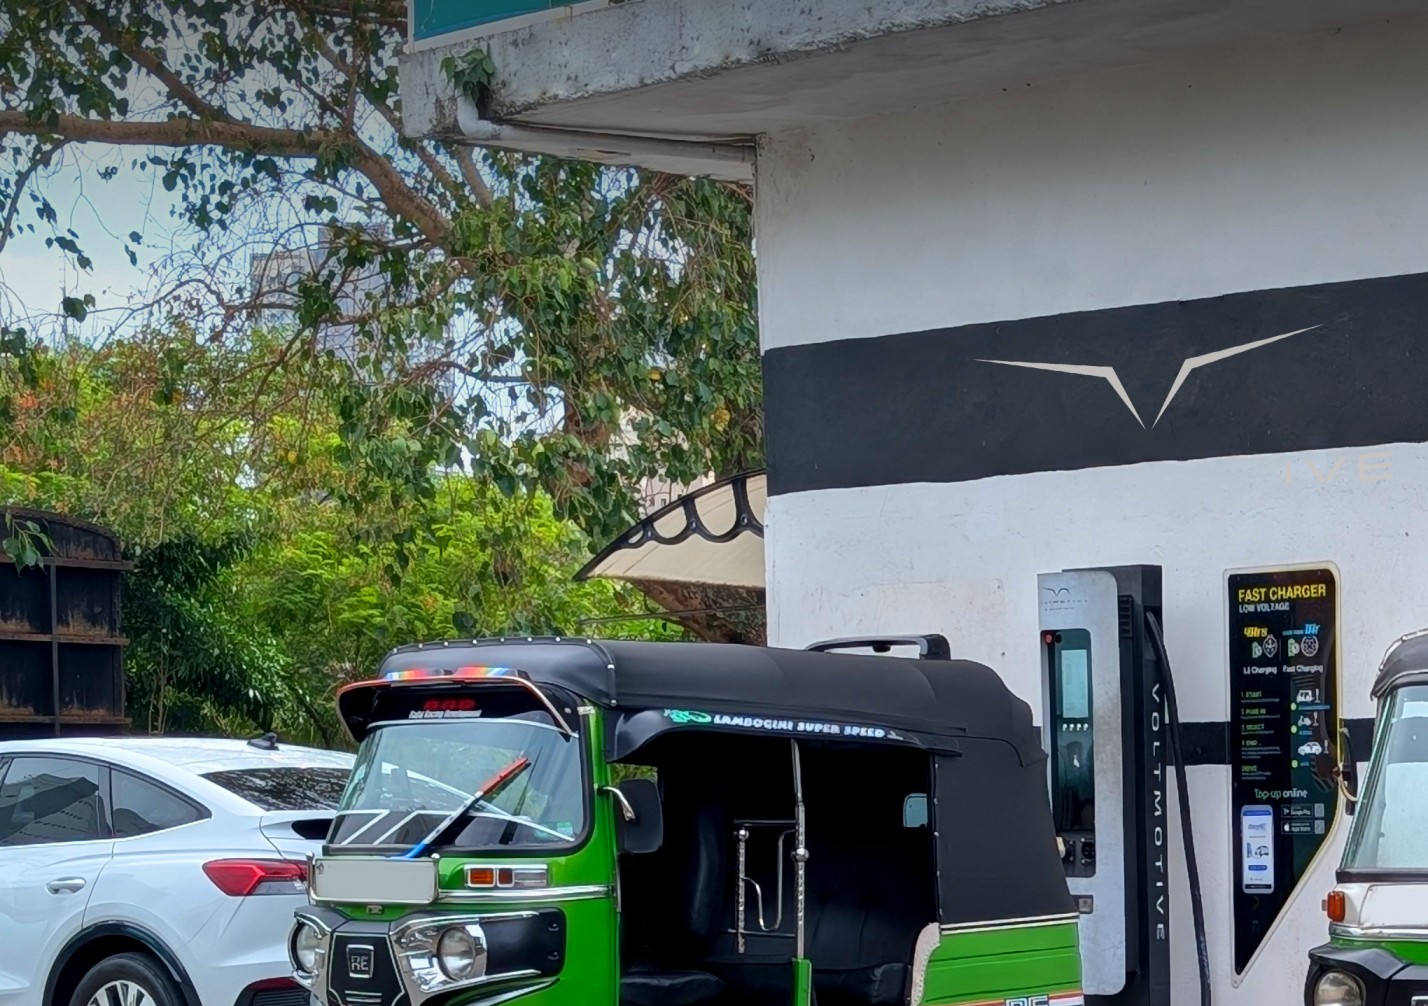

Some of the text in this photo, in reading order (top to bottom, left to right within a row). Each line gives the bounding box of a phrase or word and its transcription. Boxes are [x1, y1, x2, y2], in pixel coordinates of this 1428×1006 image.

[1238, 583, 1327, 602] FAST CHARGER
[797, 722, 840, 735] SUPER
[843, 726, 886, 738] SPEED
[1282, 787, 1309, 799] online
[1151, 683, 1166, 941] VOLTMOTIVE
[351, 955, 369, 970] RE
